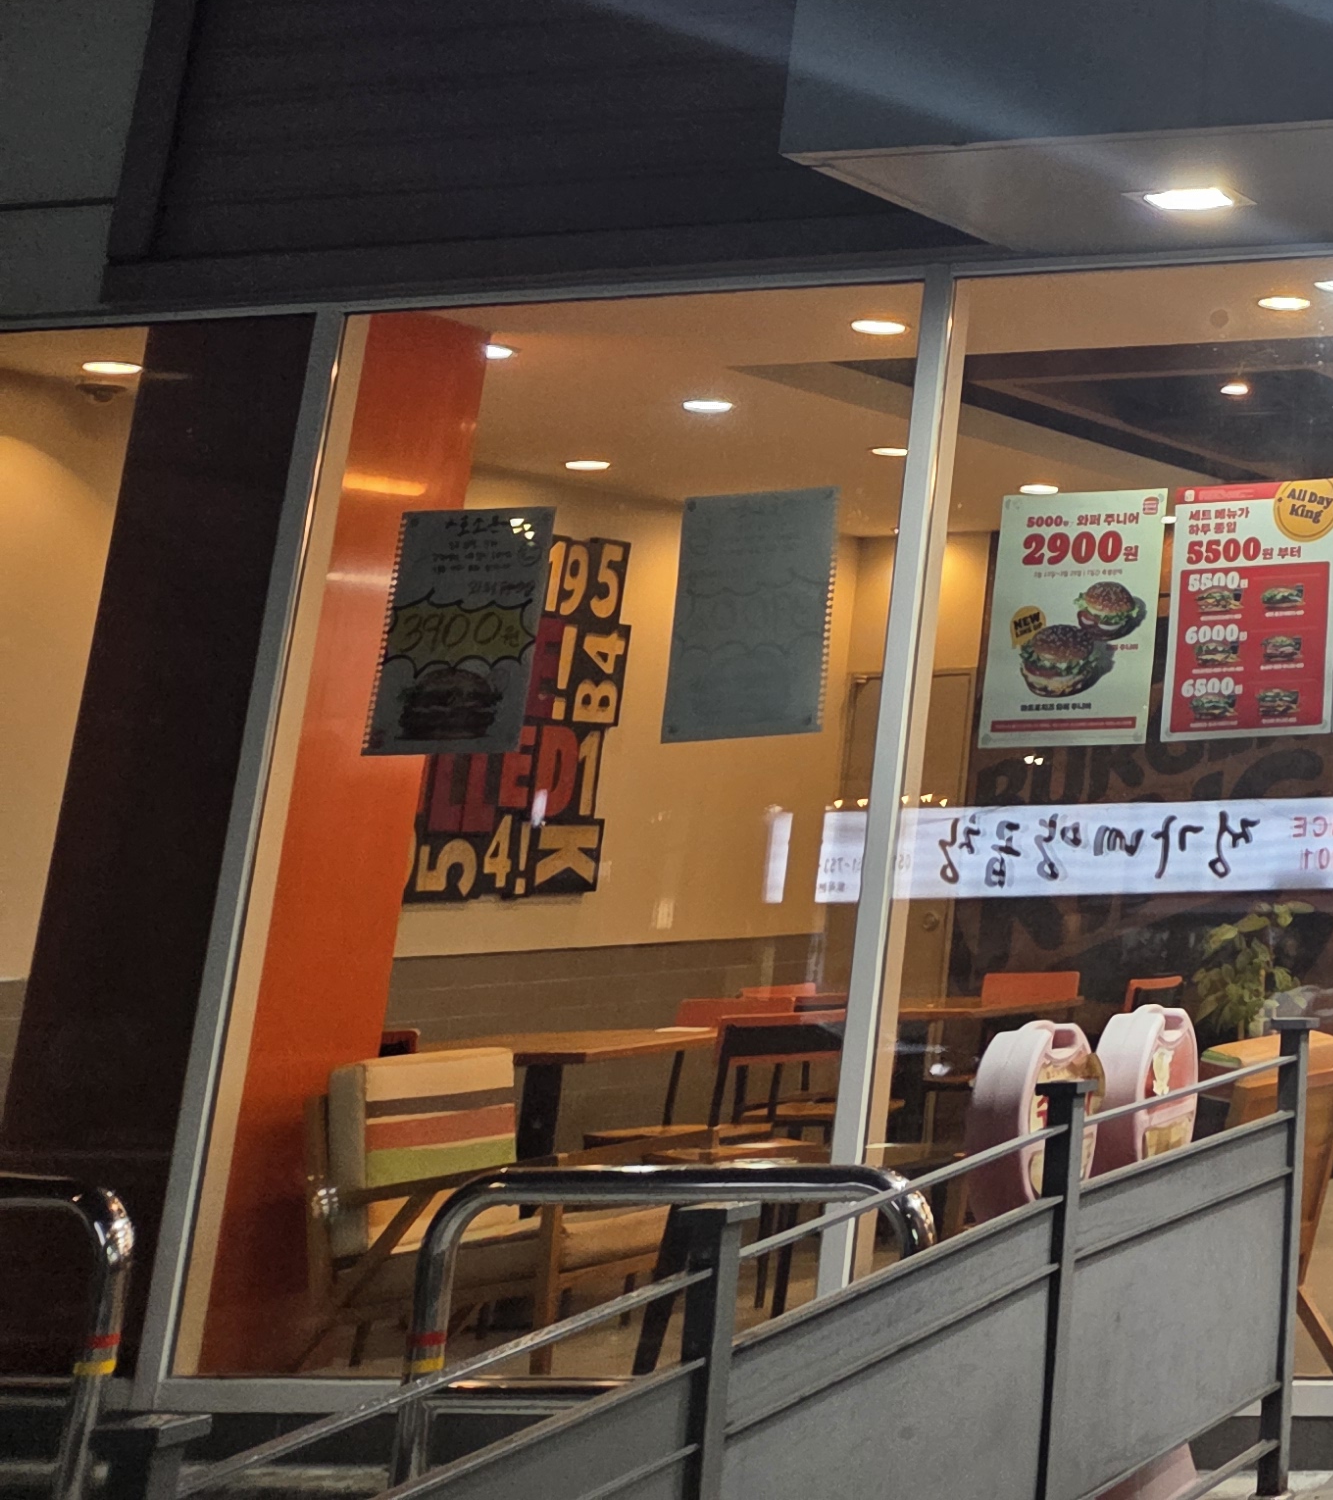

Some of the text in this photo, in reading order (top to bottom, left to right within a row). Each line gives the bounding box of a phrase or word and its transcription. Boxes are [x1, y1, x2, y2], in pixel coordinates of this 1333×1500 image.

[1287, 488, 1333, 509] All Day
[1076, 514, 1101, 526] 와퍼
[1103, 512, 1140, 526] 주니어
[1189, 507, 1250, 521] 세트 메뉴가
[1289, 504, 1323, 524] King
[1189, 523, 1211, 535] 하루
[1022, 530, 1139, 566] 2900원
[1013, 612, 1041, 628] NEW
